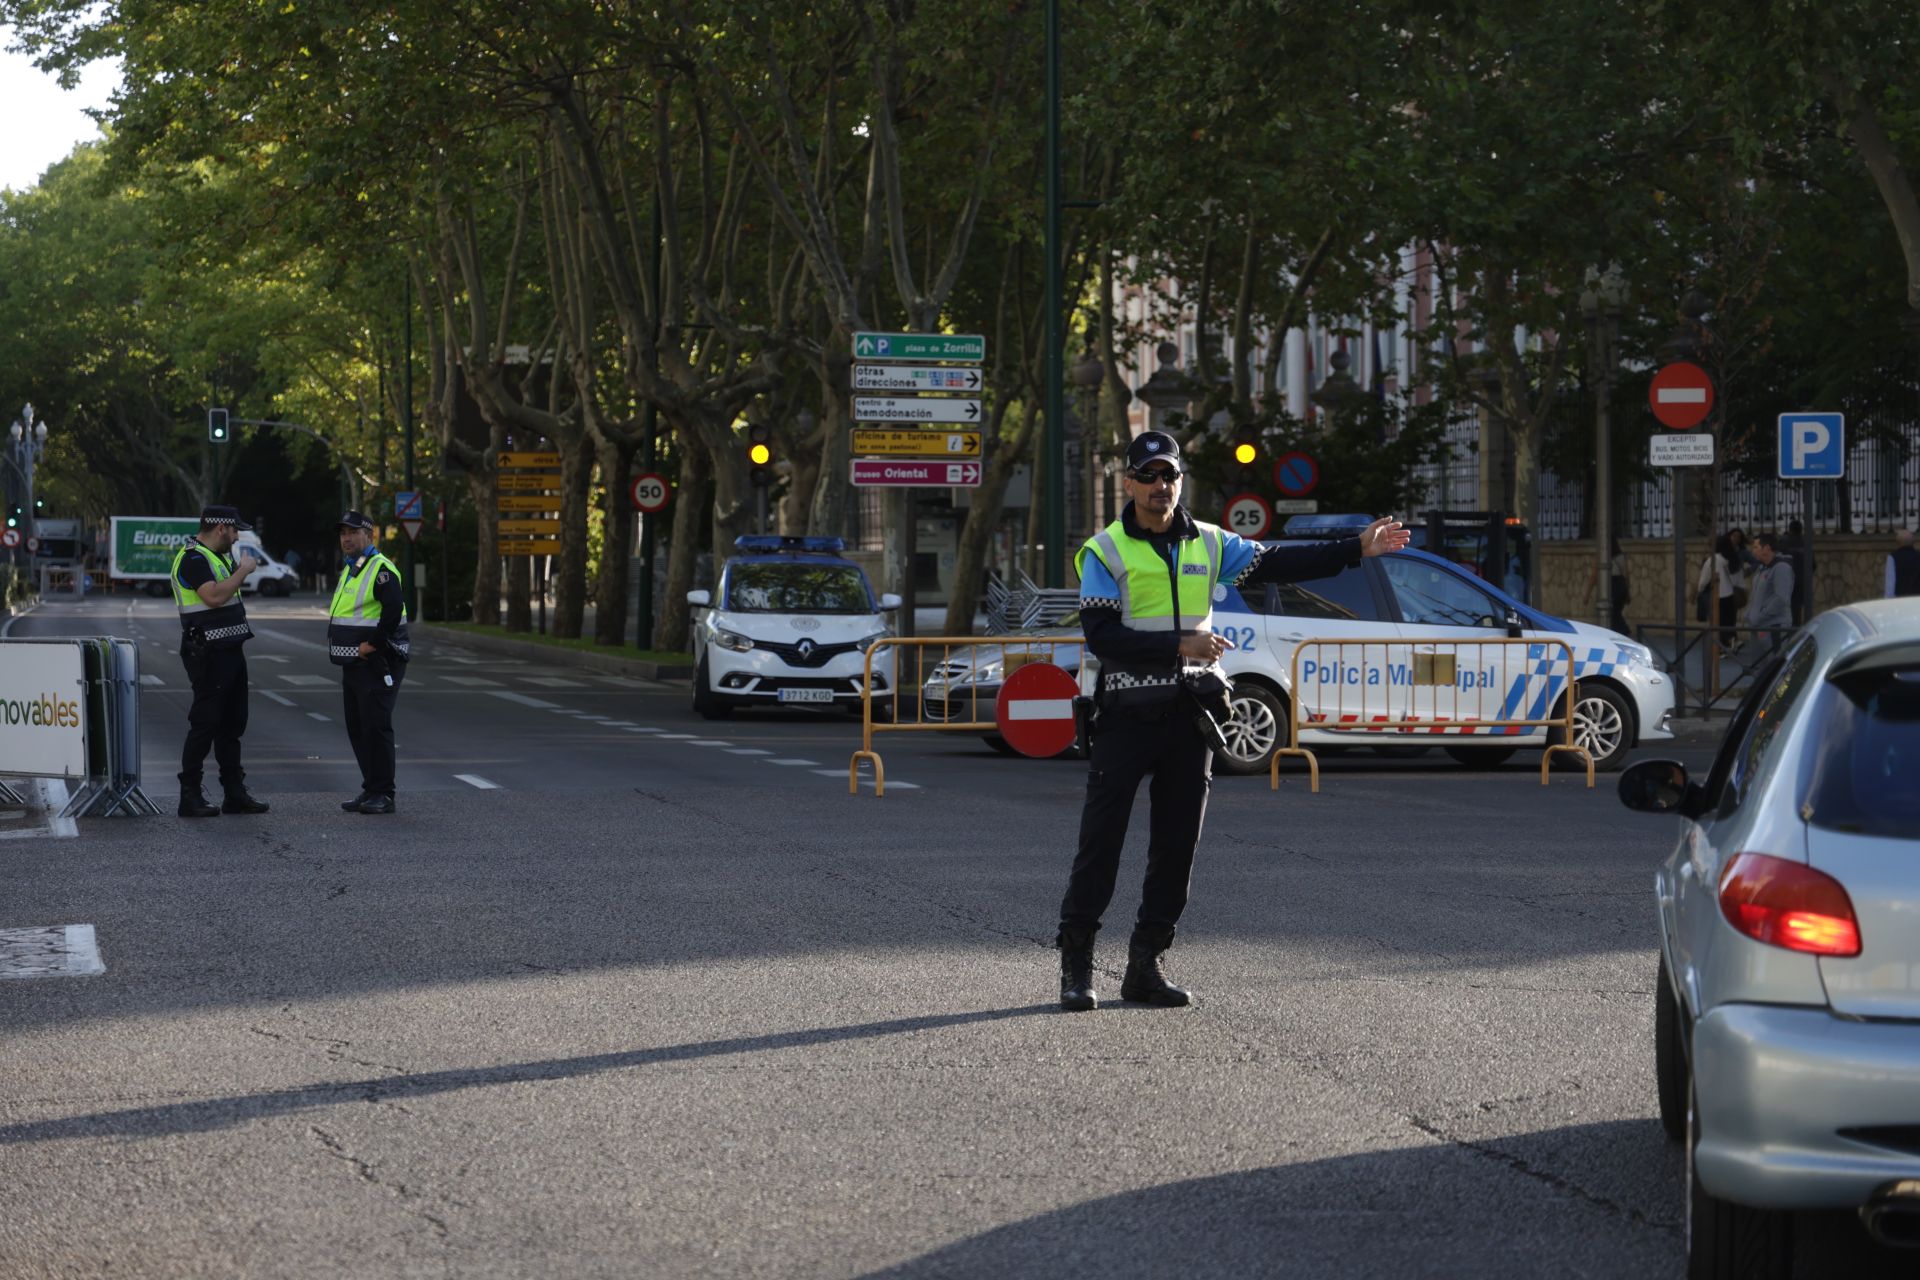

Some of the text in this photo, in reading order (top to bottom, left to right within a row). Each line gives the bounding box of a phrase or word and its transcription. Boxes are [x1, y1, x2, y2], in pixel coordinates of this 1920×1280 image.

[943, 342, 981, 353] Zorrilla
[857, 367, 885, 376] otras
[857, 378, 917, 387] direcciones
[856, 409, 933, 418] hemodonación
[856, 432, 885, 440] oficina
[907, 433, 942, 441] turismo
[1667, 435, 1696, 443] EXCEPTO
[1792, 421, 1830, 470] P
[855, 467, 929, 479] museo Oriental
[640, 486, 661, 498] 50
[1234, 510, 1260, 526] 25
[1211, 626, 1256, 651] 92
[1387, 664, 1494, 692] Mipal
[785, 691, 831, 700] 3712 KGD
[0, 692, 79, 727] novables
